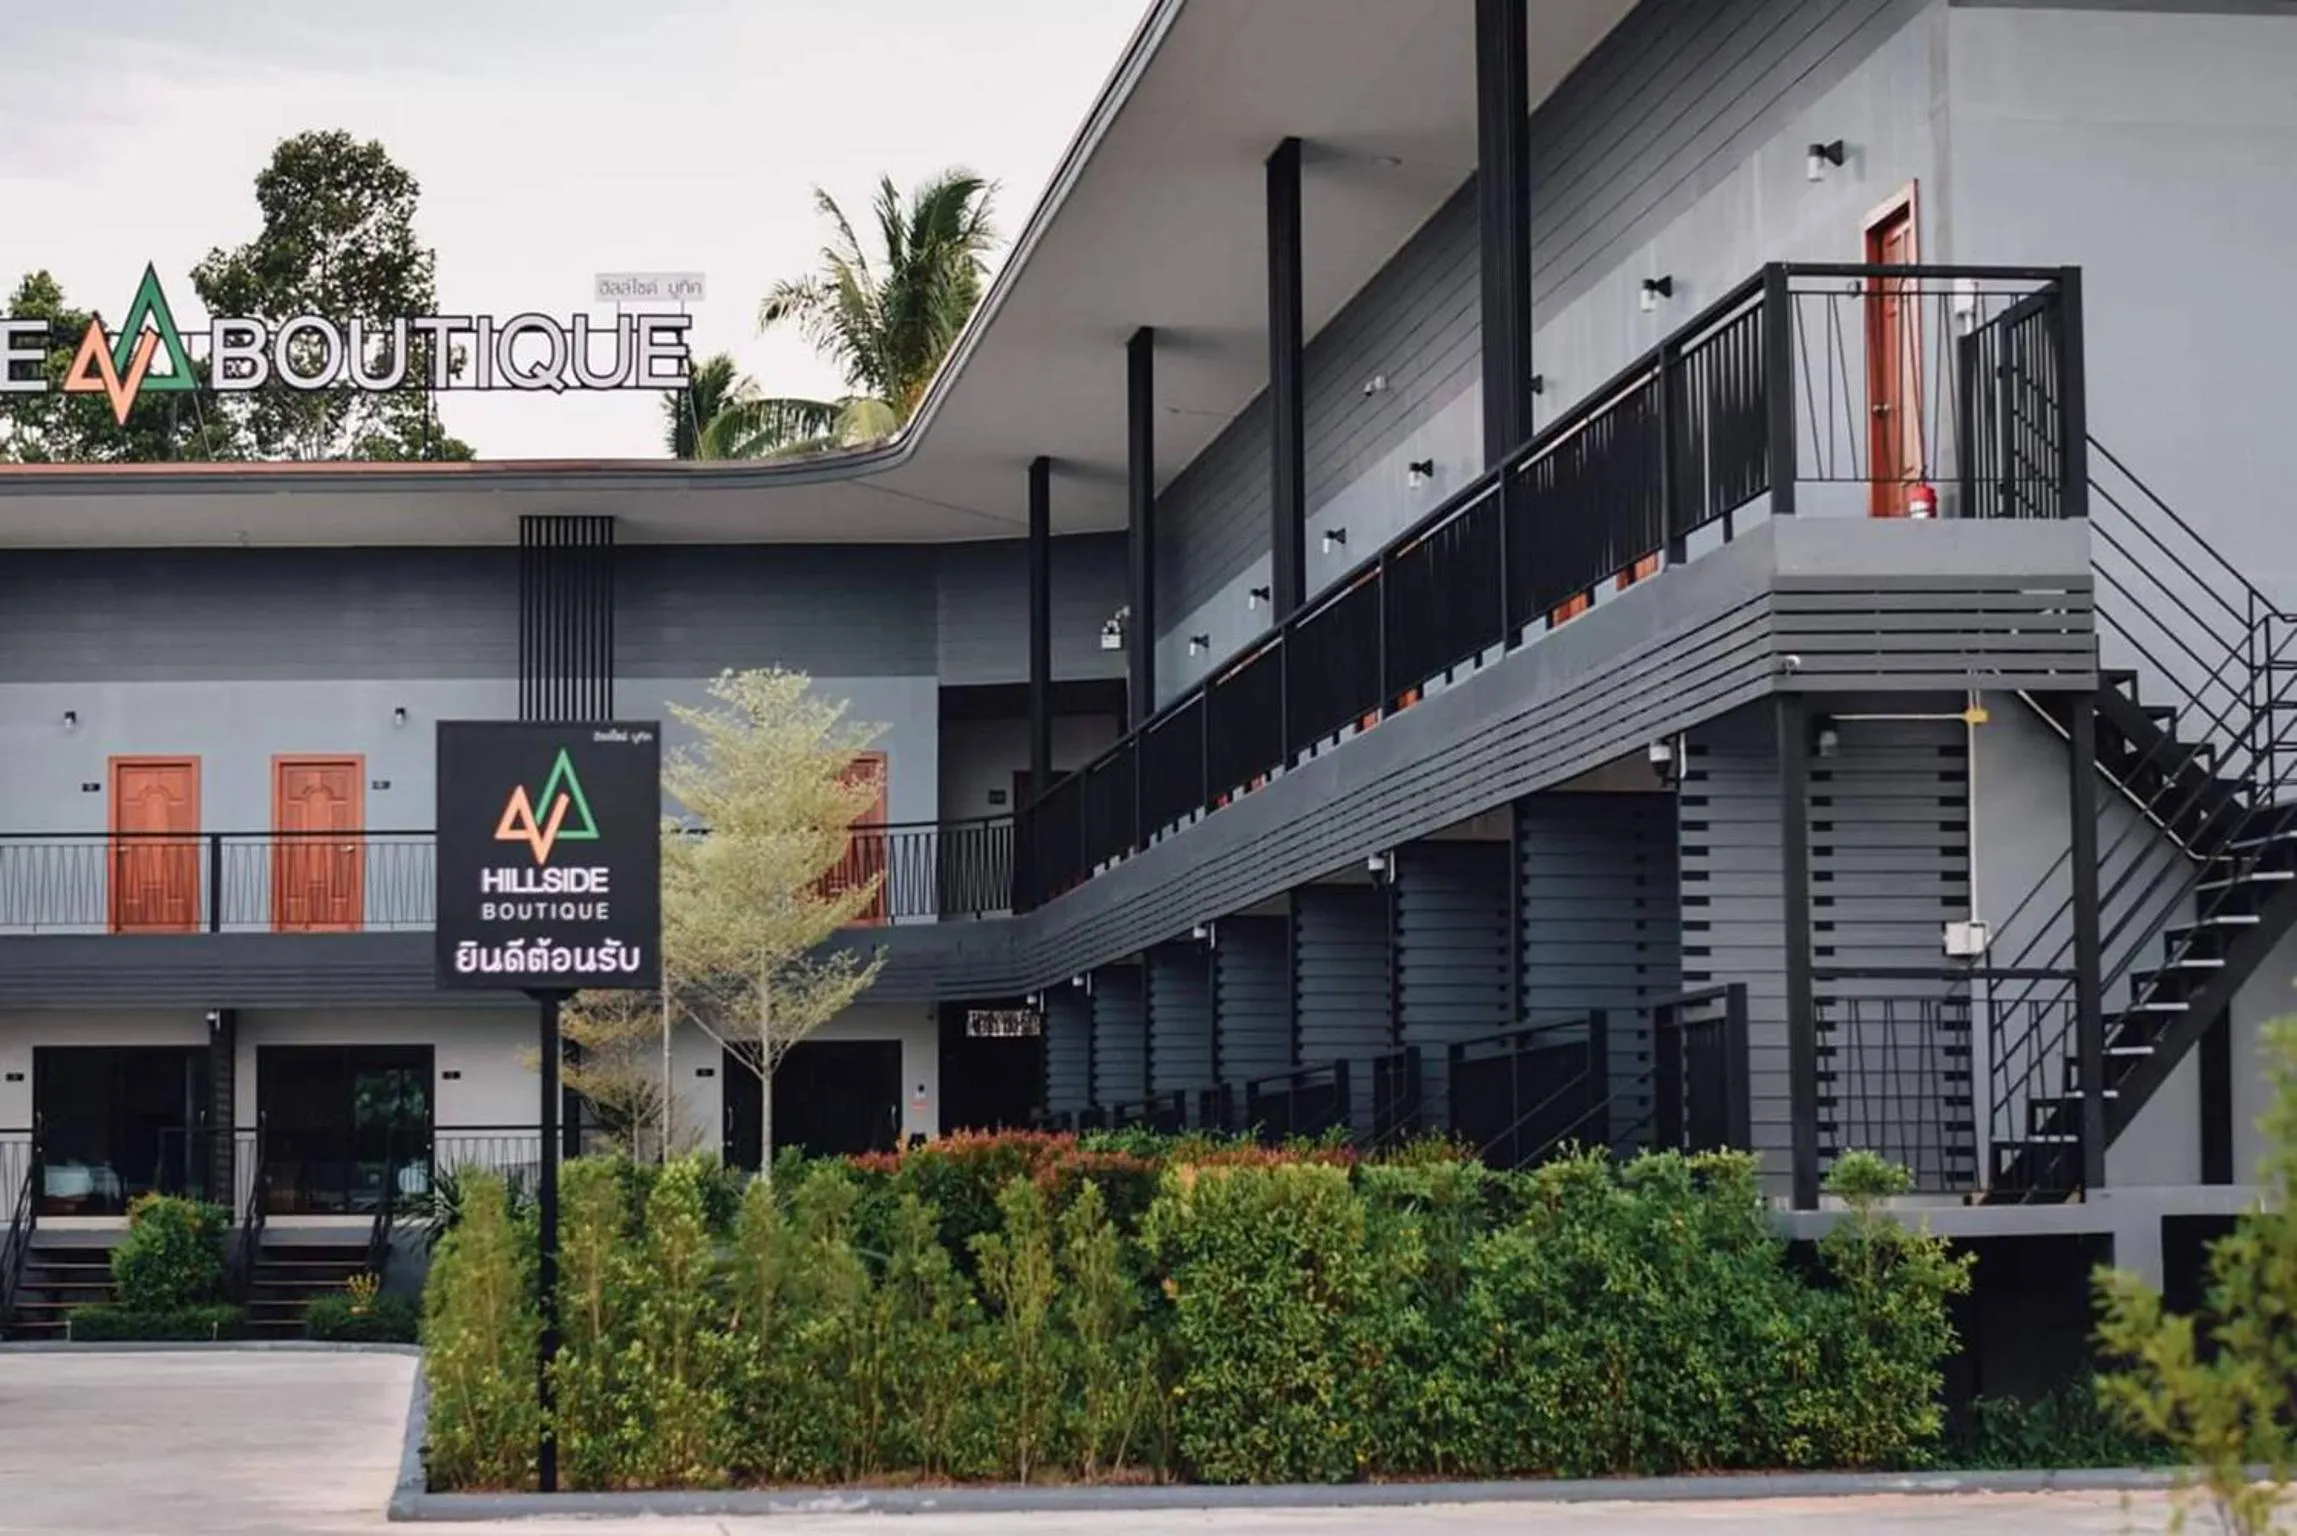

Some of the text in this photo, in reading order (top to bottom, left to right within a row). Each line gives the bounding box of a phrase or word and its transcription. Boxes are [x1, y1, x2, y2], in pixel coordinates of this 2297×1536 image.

[210, 313, 692, 396] BOUTIQUE
[481, 867, 610, 894] HILLSIDE
[481, 902, 610, 921] BOUTIQUE
[455, 937, 642, 973] ยินดีต้อนรับ
